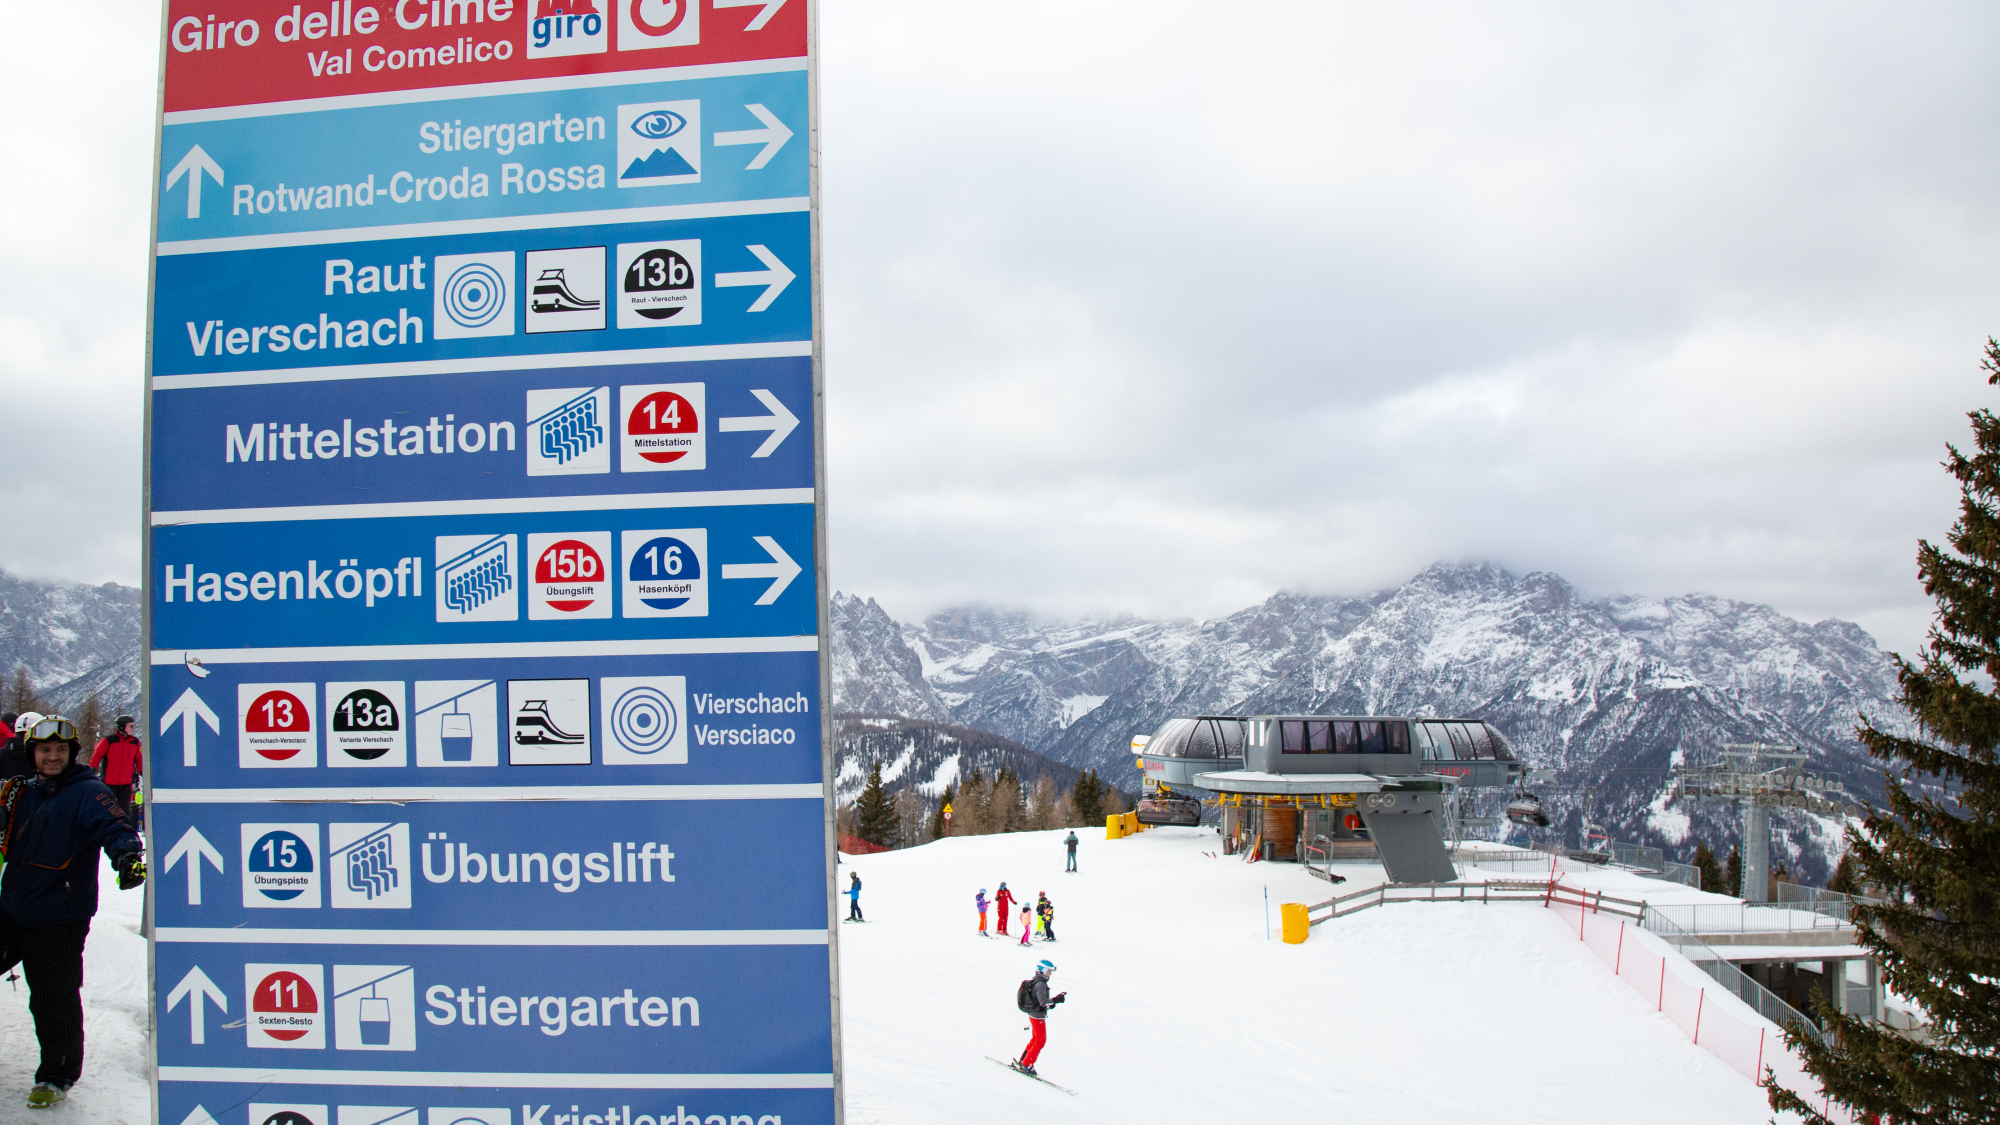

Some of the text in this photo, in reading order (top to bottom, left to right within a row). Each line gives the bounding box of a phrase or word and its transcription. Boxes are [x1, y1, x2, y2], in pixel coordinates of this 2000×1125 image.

[172, 0, 513, 52] Giro delle Cime
[533, 9, 601, 47] giro
[308, 37, 513, 76] Val Comelico
[419, 113, 605, 155] Stiergarten
[233, 163, 605, 215] Rotwand-Croda Rossa
[325, 256, 425, 295] Raut
[632, 256, 689, 287] 13b
[651, 294, 688, 303] Vierschach
[186, 308, 422, 356] Vierschach
[644, 400, 681, 429] 14
[227, 414, 515, 462] Mittelstation
[635, 439, 691, 447] Mittelstation
[544, 549, 596, 577] 15b
[645, 546, 682, 575] 16
[166, 557, 421, 607] Hasenköpfl
[547, 587, 593, 596] Übungslift
[639, 584, 691, 594] Hasenköpfl
[263, 699, 293, 727] 13
[342, 698, 392, 726] 13a
[693, 692, 808, 714] Vierschach
[694, 725, 795, 745] Versciaco
[263, 840, 296, 867] 15
[422, 833, 675, 893] Übungslift
[255, 875, 308, 886] Übungspiste
[270, 980, 298, 1007] 11
[259, 1016, 312, 1025] Sexten-Sesto
[425, 985, 699, 1036] Stiergarten
